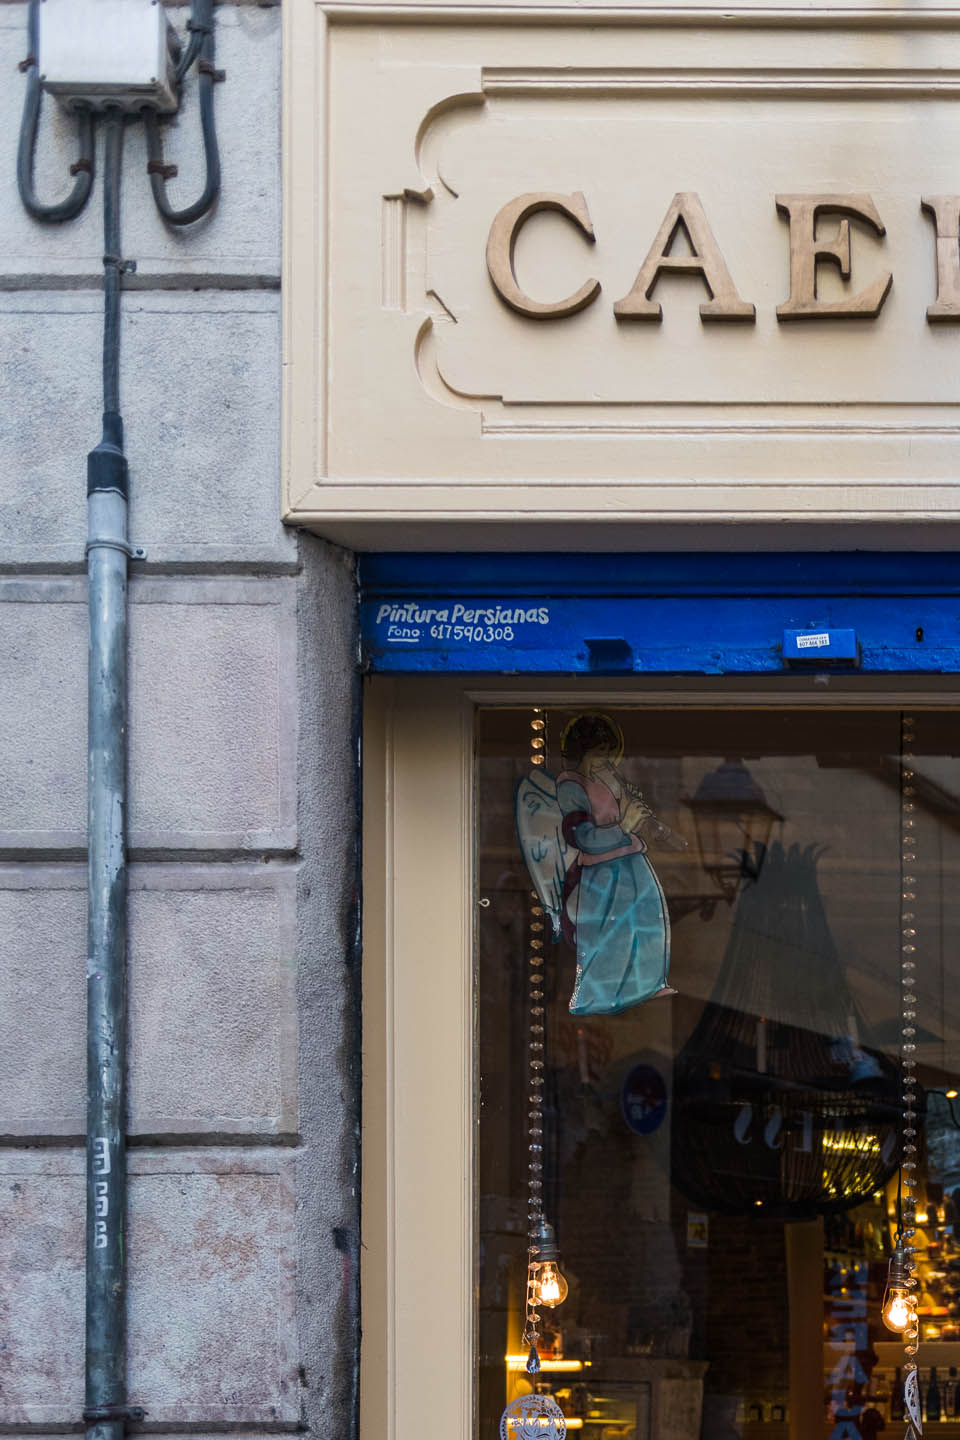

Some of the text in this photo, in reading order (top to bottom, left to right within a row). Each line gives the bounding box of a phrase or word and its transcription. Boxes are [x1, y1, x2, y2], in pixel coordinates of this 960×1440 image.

[375, 602, 550, 626] Pintura Persianas
[429, 624, 514, 642] 617590308
